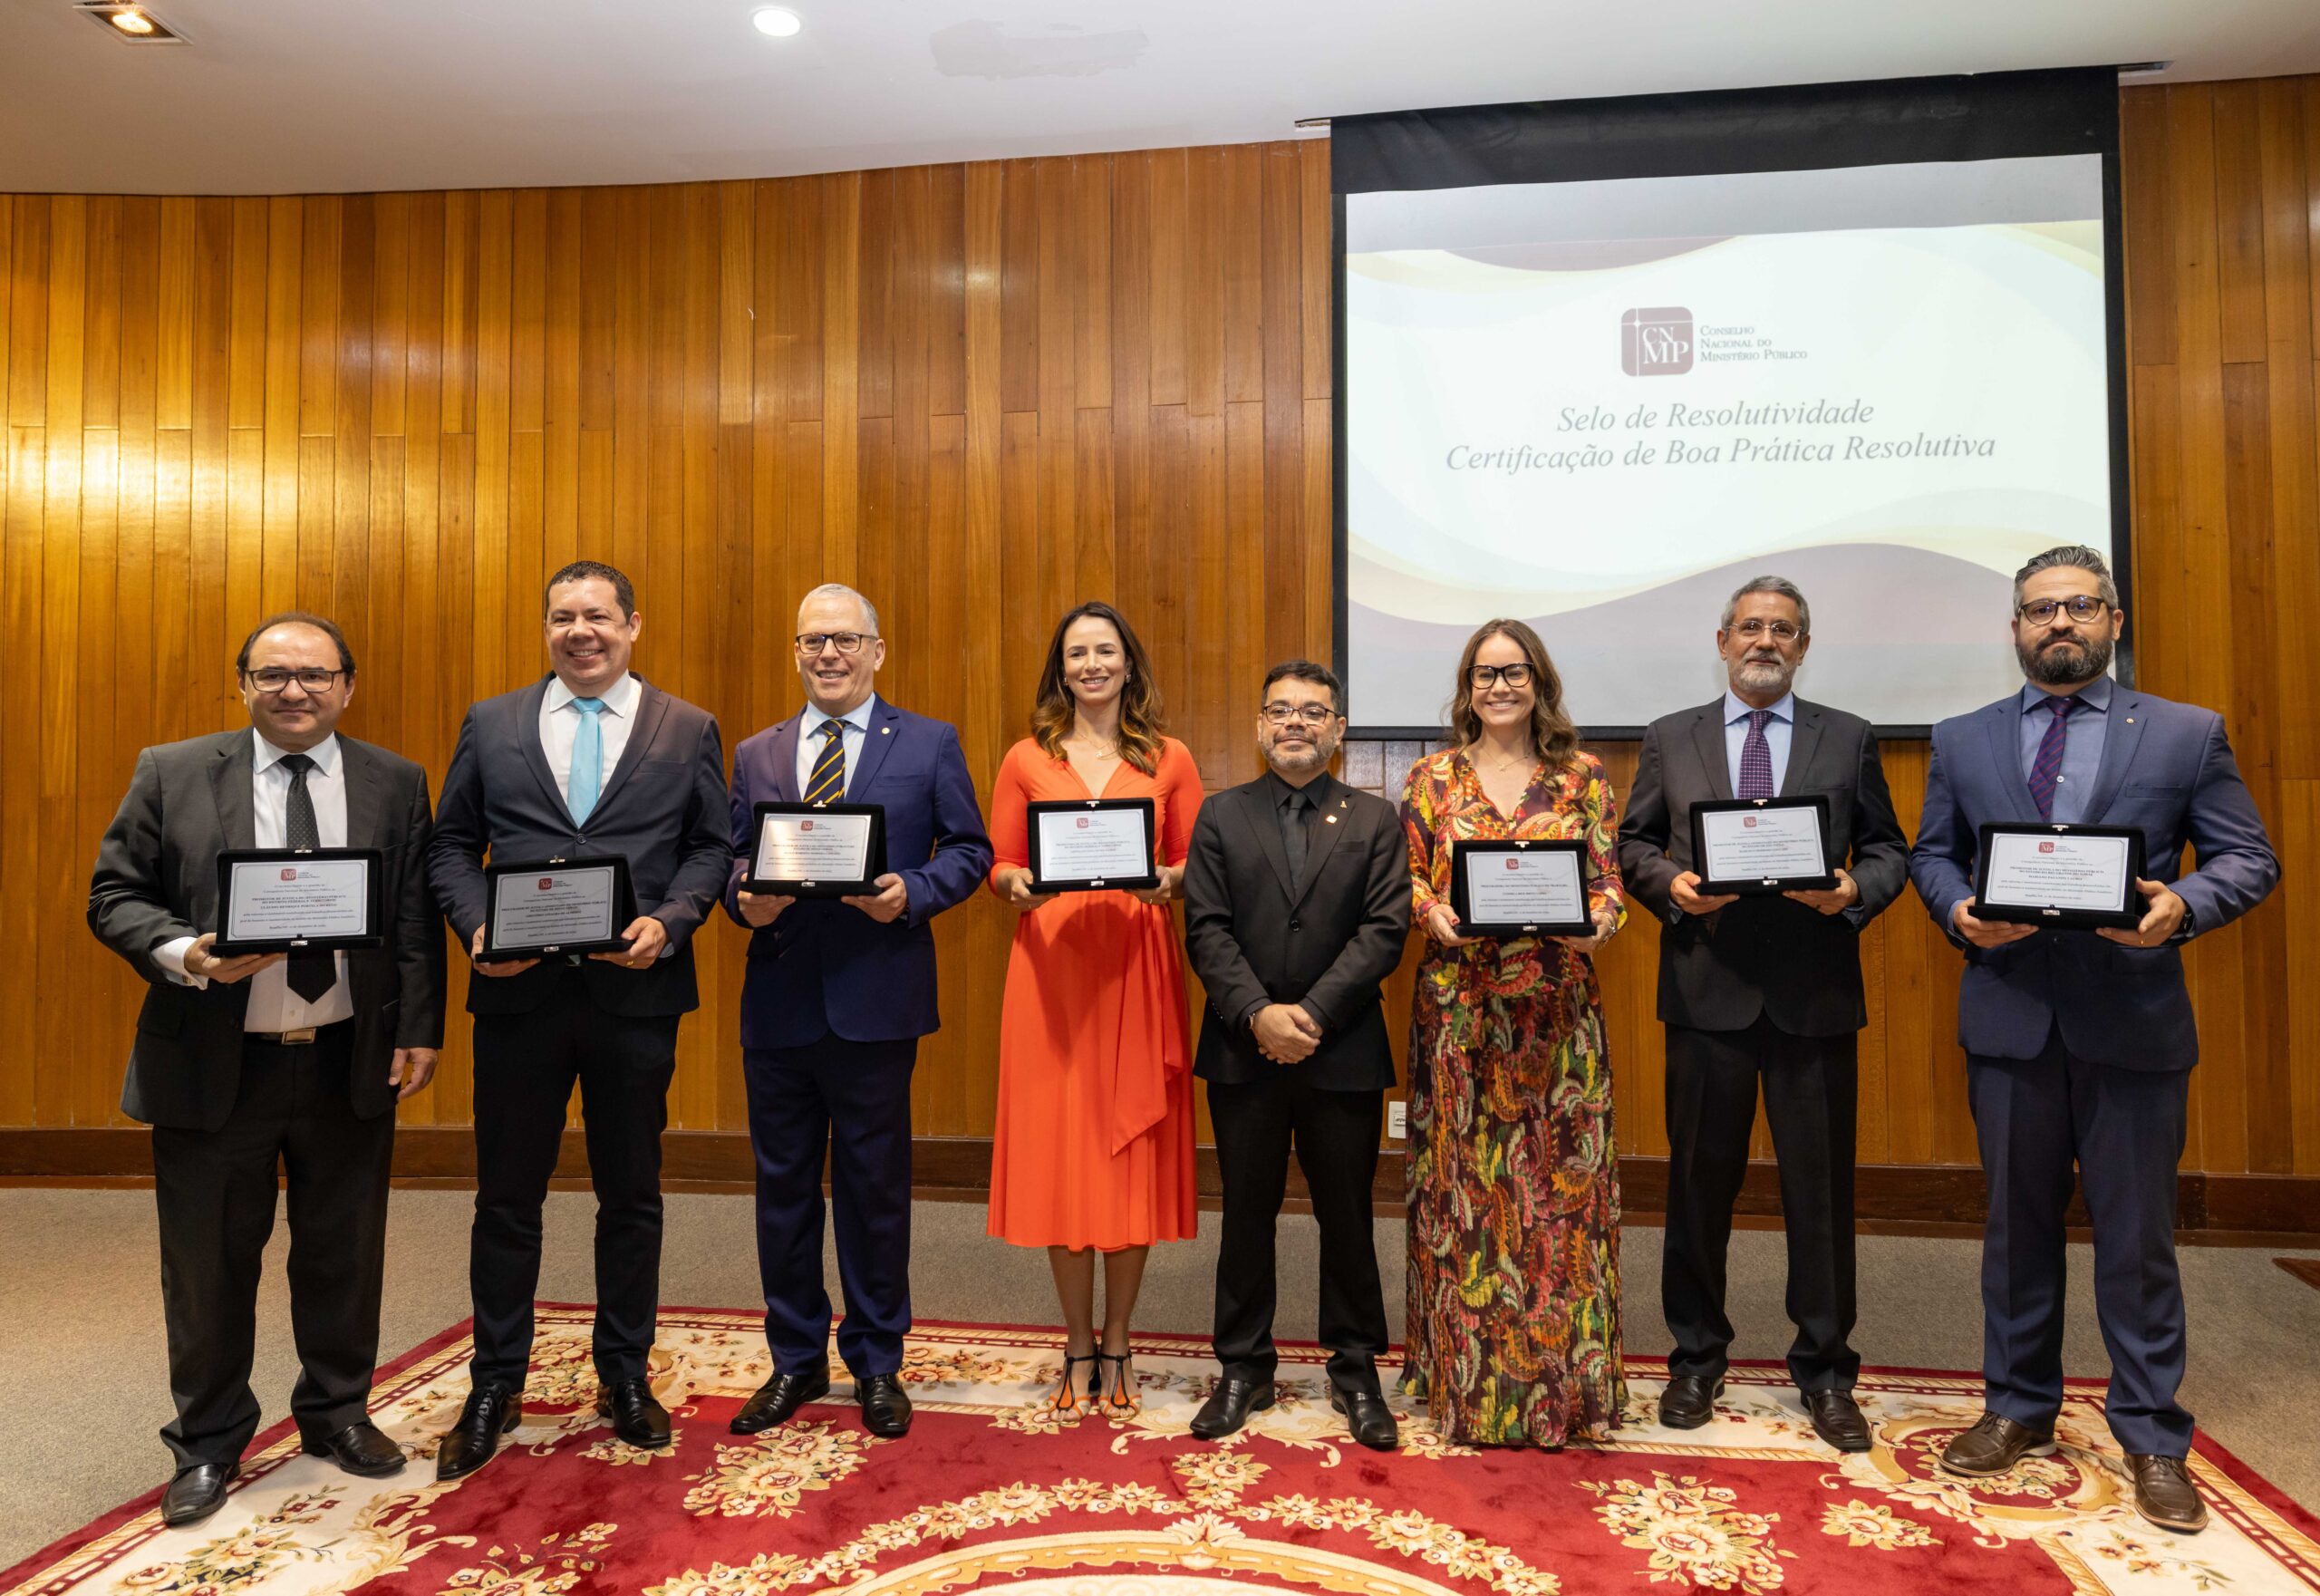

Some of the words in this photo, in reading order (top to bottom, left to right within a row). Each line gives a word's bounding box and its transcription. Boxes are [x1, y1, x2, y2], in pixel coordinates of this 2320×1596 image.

[1557, 405, 1616, 432] Selo
[1625, 403, 1658, 430] de
[1667, 398, 1874, 428] Resolutividade
[1446, 443, 1614, 476] Certificação
[1623, 440, 1657, 466] de
[1665, 440, 1721, 464] Boa
[1729, 436, 1835, 463] Prática
[1842, 431, 1996, 460] Resolutiva
